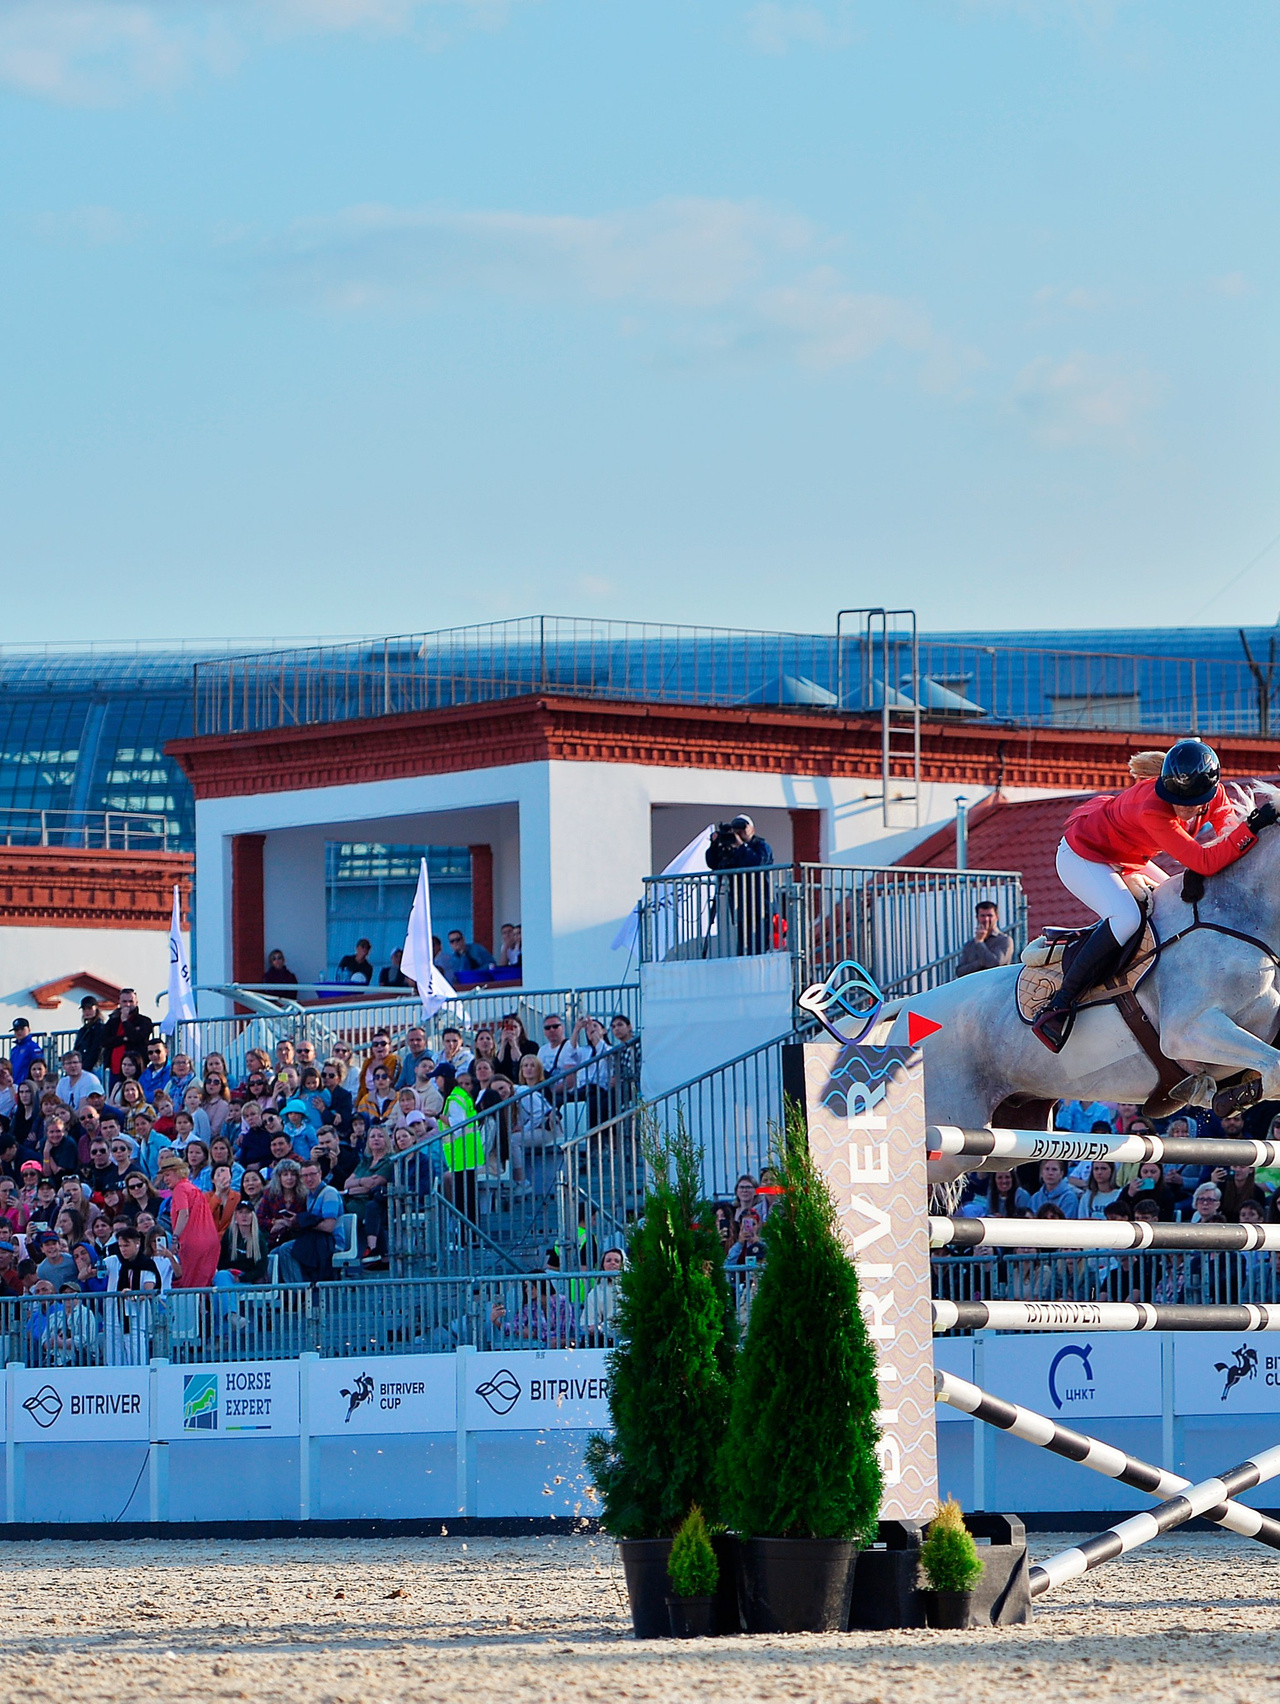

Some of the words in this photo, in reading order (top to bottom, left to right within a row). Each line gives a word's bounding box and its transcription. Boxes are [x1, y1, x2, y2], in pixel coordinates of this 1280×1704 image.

[1030, 1139, 1109, 1160] BITRIVER
[1024, 1303, 1101, 1323] BITRIVER
[225, 1372, 271, 1391] HORSE
[380, 1382, 425, 1395] BITRIVER
[380, 1398, 401, 1410] CUP
[1065, 1388, 1096, 1402] ЦНКТ
[70, 1394, 141, 1415] BITRIVER
[225, 1399, 272, 1416] EXPERT
